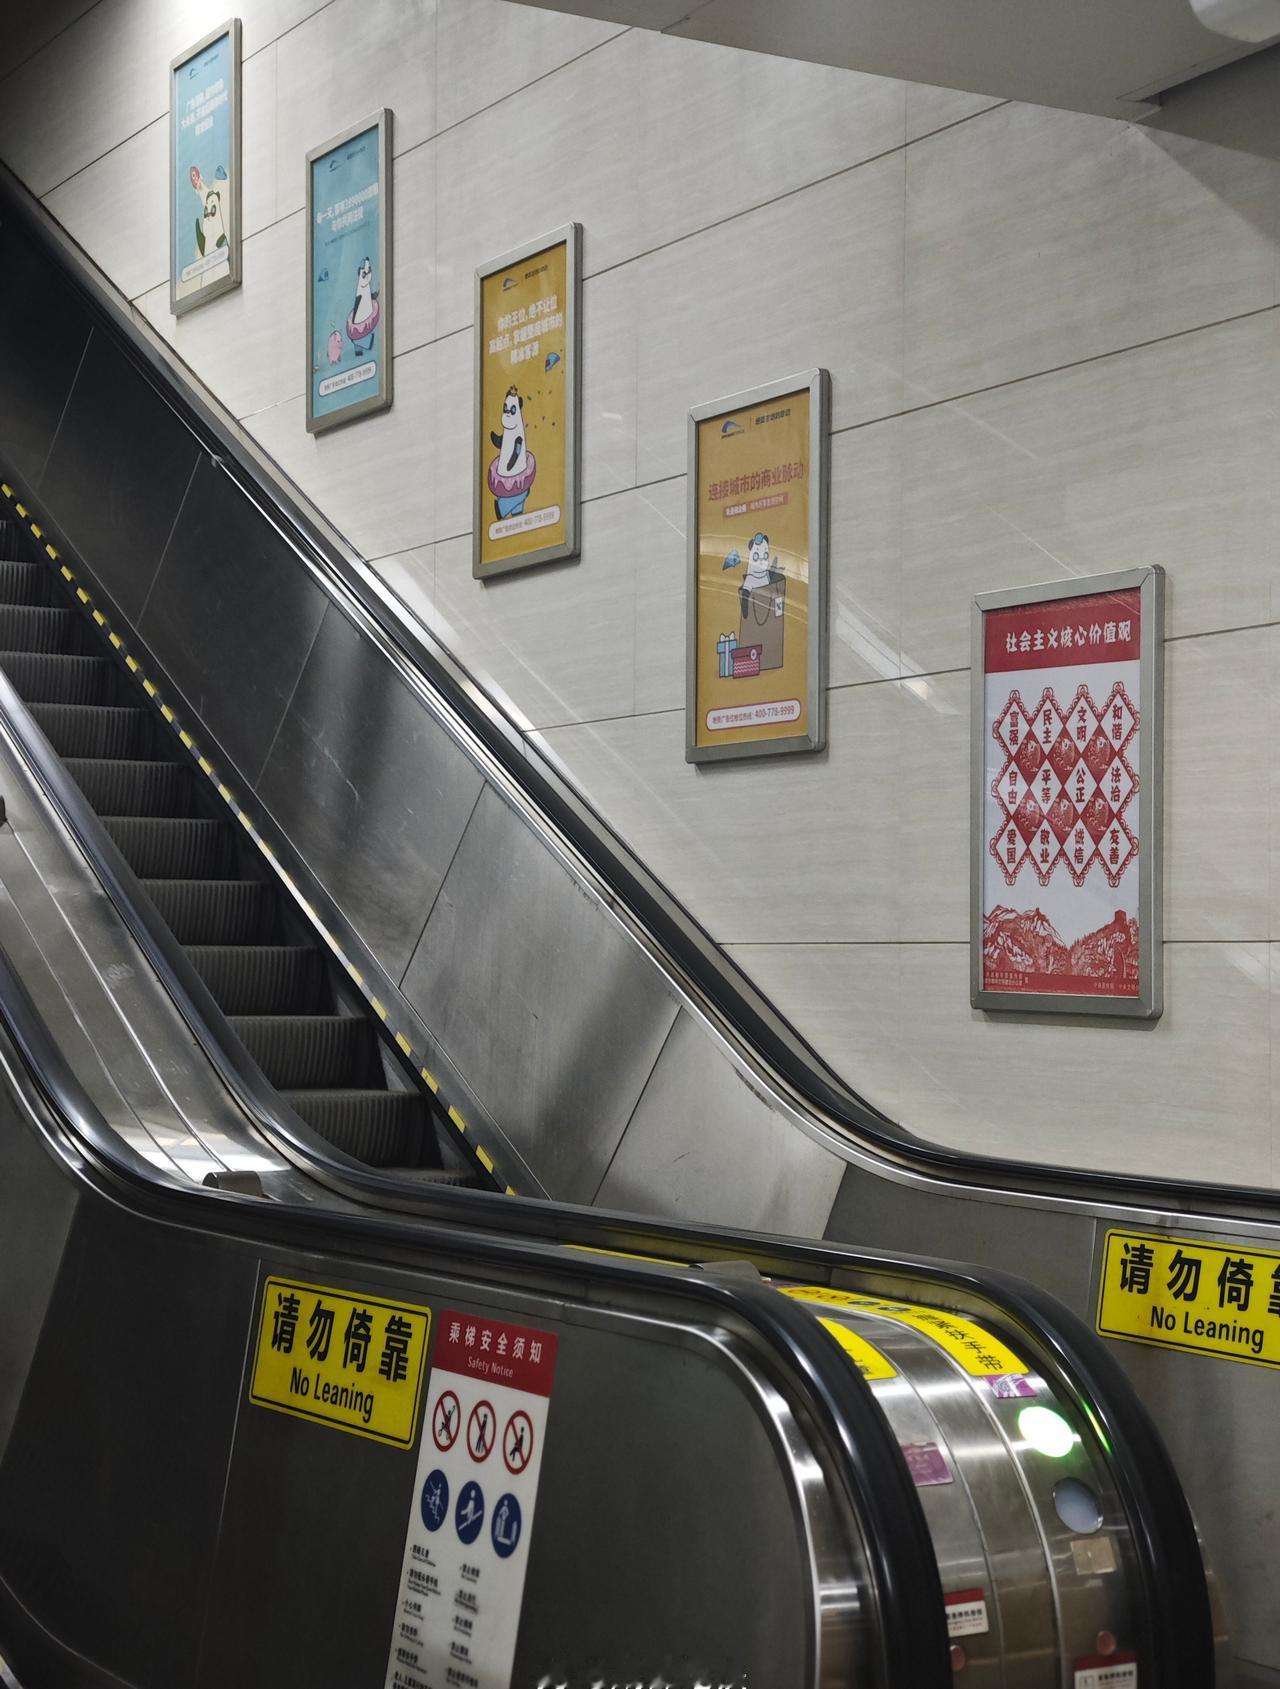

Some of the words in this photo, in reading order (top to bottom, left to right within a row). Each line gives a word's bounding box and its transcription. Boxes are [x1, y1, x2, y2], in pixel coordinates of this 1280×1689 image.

[1006, 620, 1131, 653] 社会主义核心价值观
[1009, 711, 1020, 746] 富强
[1042, 709, 1052, 744] 民主
[1076, 707, 1087, 742] 文明
[1111, 704, 1122, 741] 和谐
[1008, 770, 1018, 804] 自由
[1041, 769, 1052, 804] 平等
[1075, 767, 1086, 803] 公正
[1110, 766, 1121, 802] 法治
[1006, 830, 1017, 864] 爱国
[1040, 829, 1050, 864] 敬业
[1073, 828, 1084, 864] 诚信
[1109, 829, 1120, 865] 友善
[271, 1292, 413, 1383] 请勿倚靠
[448, 1321, 543, 1364] 乘梯安全须知
[1150, 1305, 1176, 1331] No
[1183, 1311, 1265, 1354] Leaning
[467, 1355, 490, 1375] Safety
[490, 1361, 514, 1378] Notice
[289, 1366, 310, 1397] No
[313, 1373, 374, 1423] Leaning
